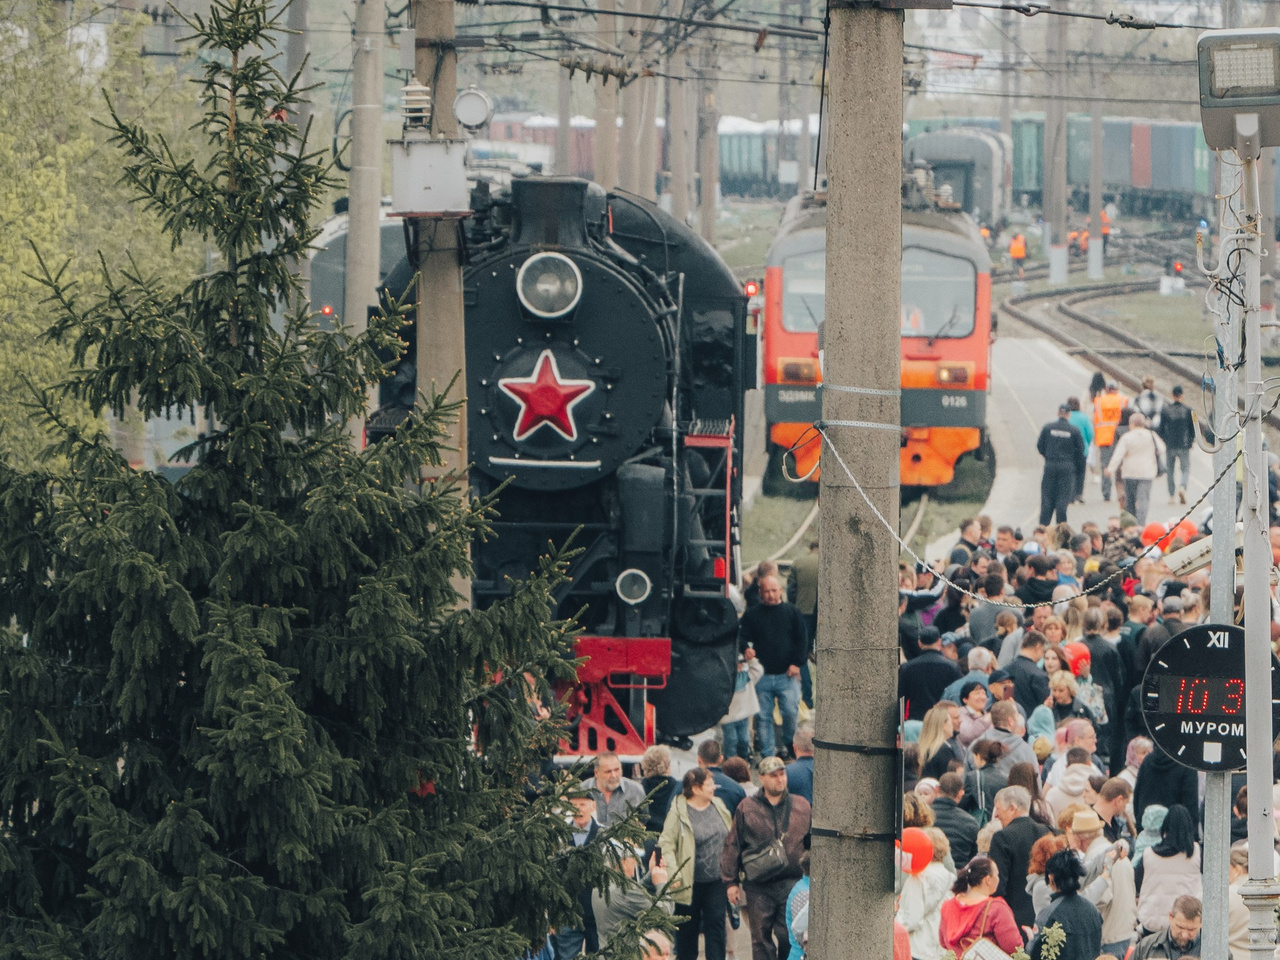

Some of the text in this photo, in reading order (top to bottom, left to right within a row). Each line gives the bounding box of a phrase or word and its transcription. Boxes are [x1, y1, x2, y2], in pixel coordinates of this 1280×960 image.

[1207, 631, 1229, 648] XII
[1176, 679, 1208, 713] 10
[1181, 721, 1244, 736] МУРОМ
